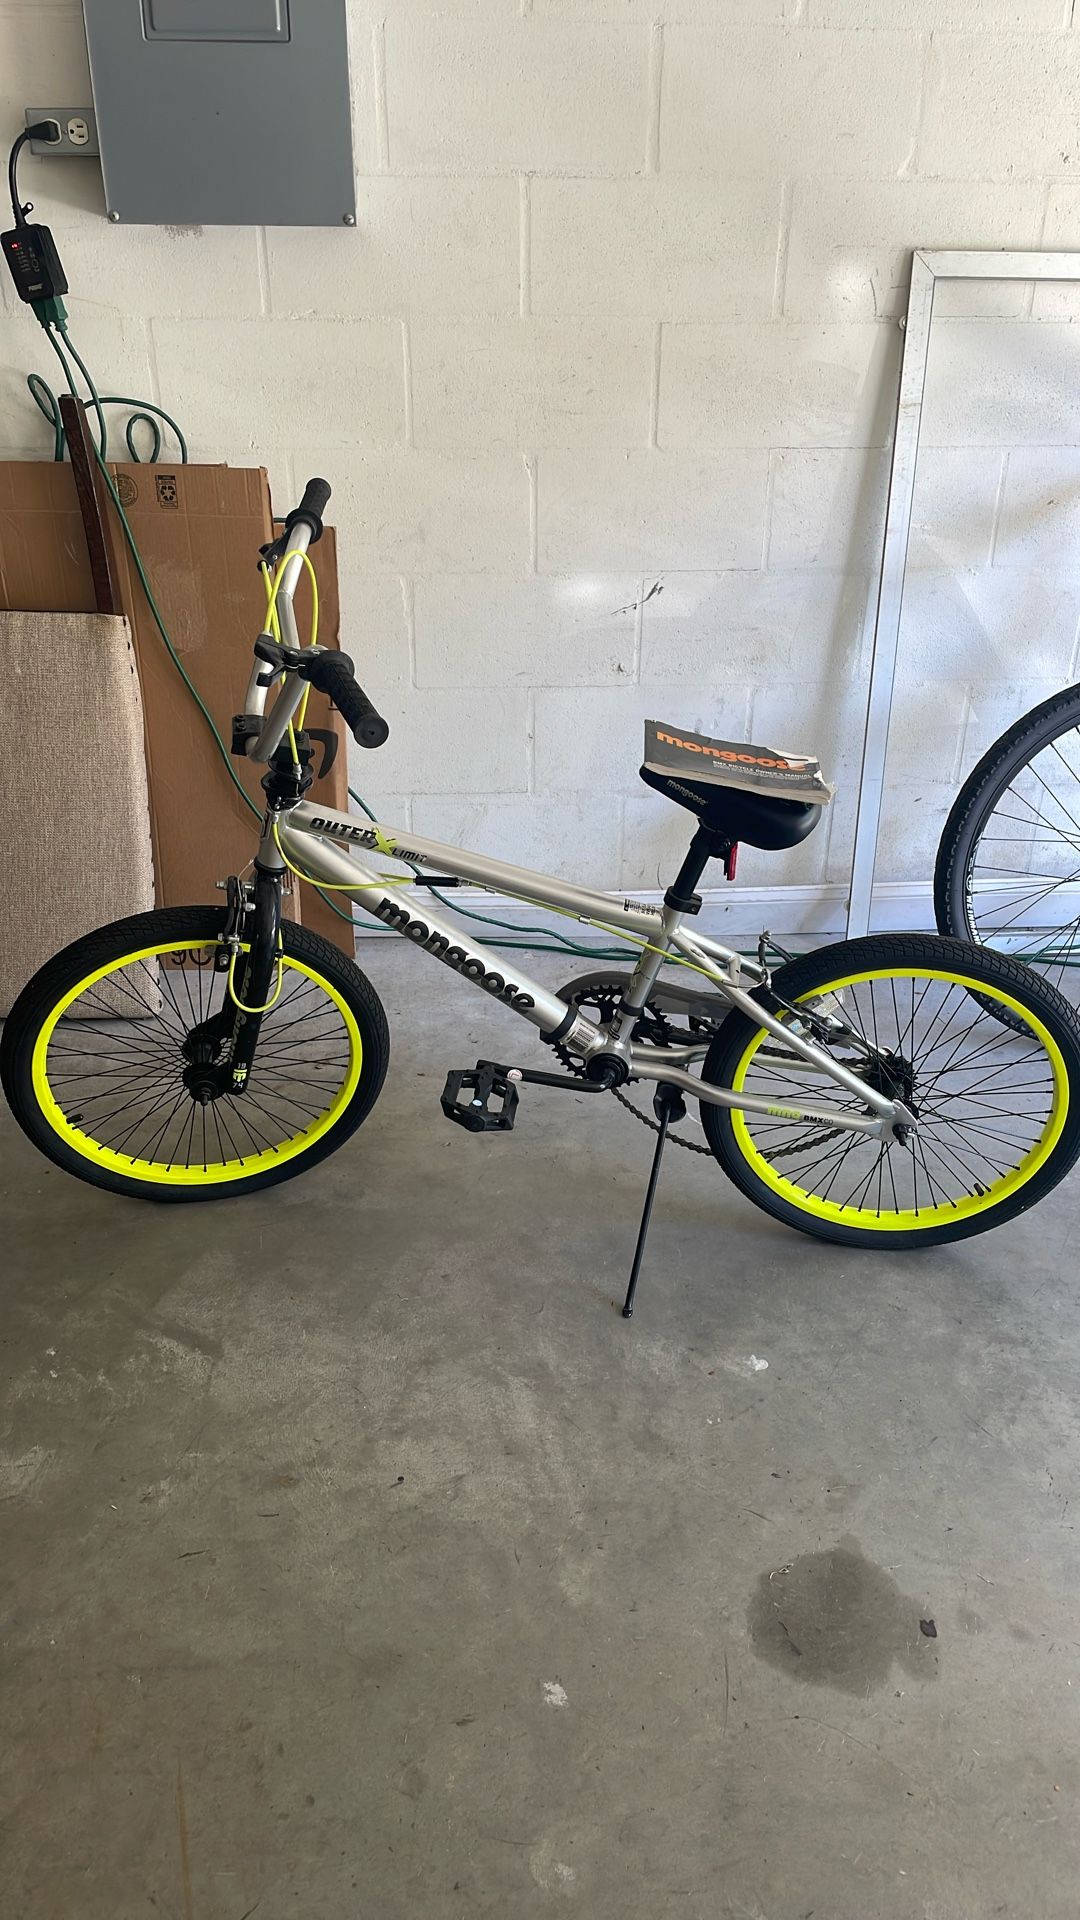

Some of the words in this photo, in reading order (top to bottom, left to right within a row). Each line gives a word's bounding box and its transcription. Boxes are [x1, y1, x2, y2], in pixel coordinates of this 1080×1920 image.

[666, 779, 707, 805] mongoose
[309, 817, 377, 845] OUTER
[391, 847, 427, 863] LIMIT
[374, 898, 535, 1013] mongoose
